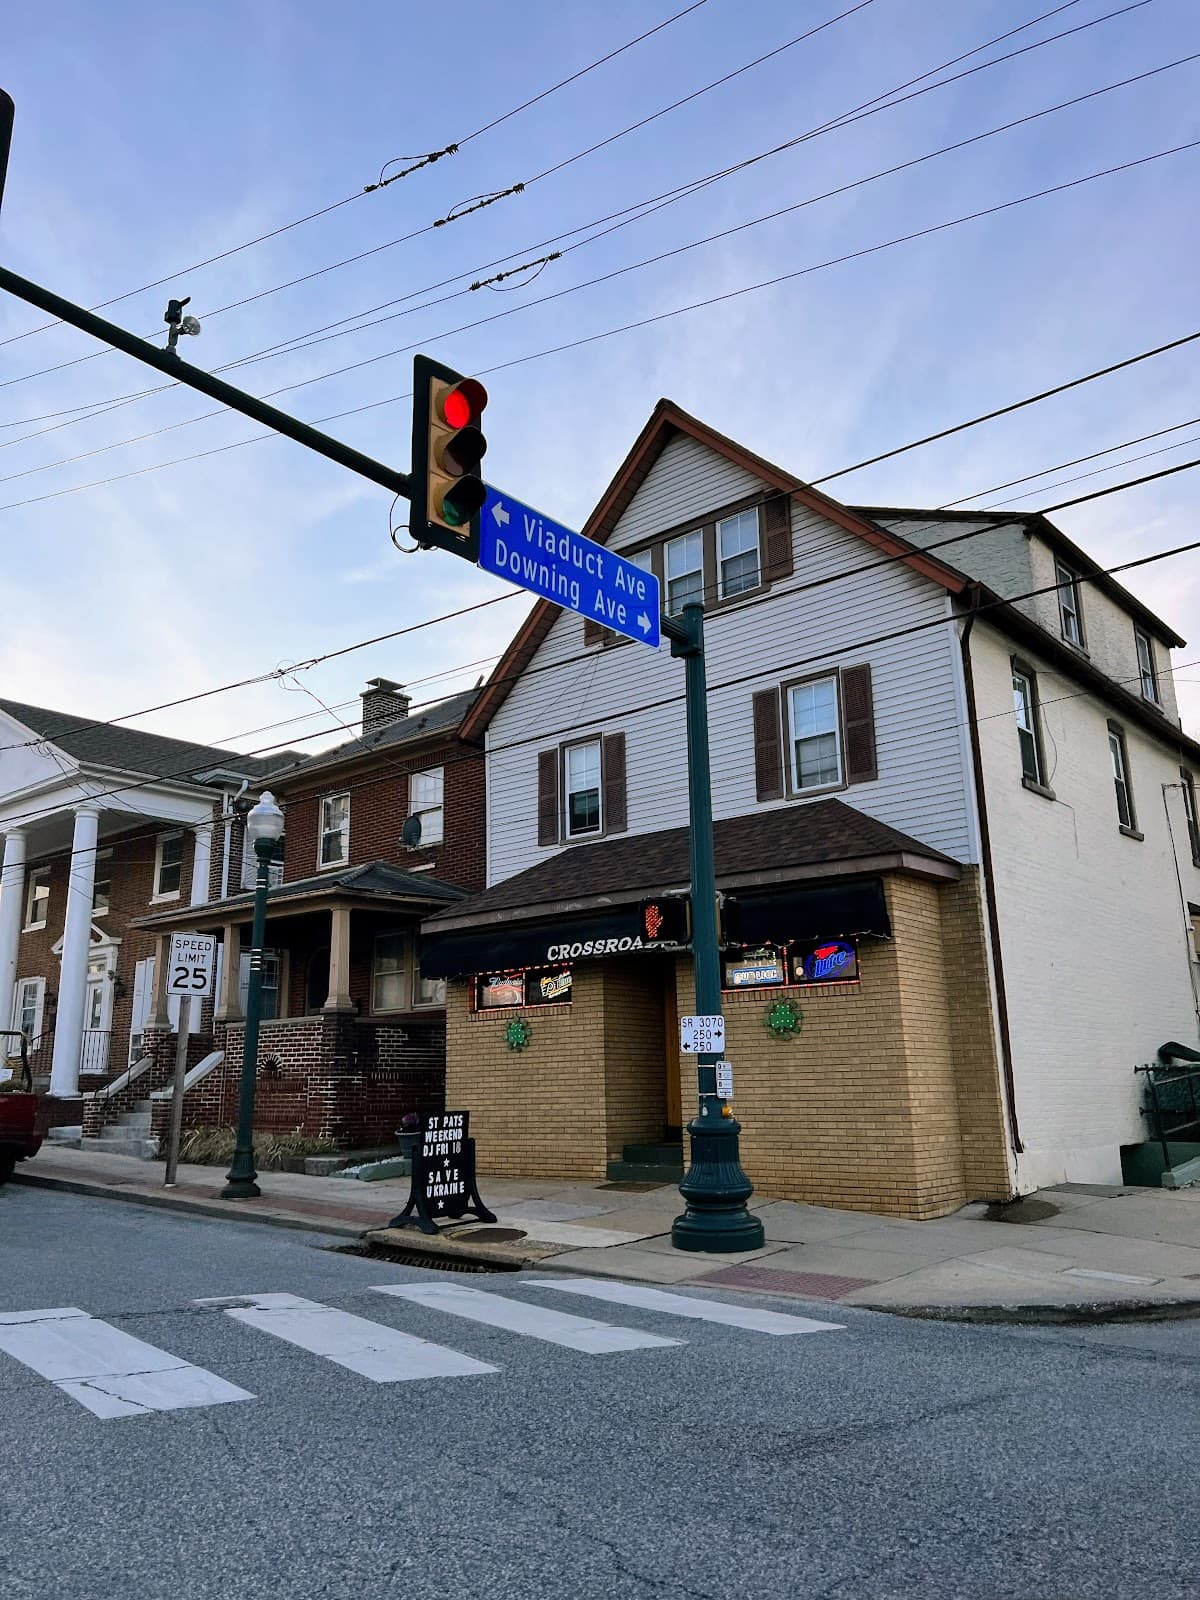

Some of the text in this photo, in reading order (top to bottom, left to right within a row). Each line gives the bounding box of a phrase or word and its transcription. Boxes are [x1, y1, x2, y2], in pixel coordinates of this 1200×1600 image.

[523, 514, 646, 601] Viaduct Ave
[495, 538, 627, 625] Downing Ave
[175, 939, 212, 951] SPEED
[547, 936, 664, 961] CROSSROA
[177, 952, 206, 964] LIMIT
[173, 966, 207, 989] 25
[682, 1017, 724, 1028] SR 3070
[693, 1029, 712, 1040] 250
[693, 1041, 712, 1052] 250
[428, 1115, 463, 1130] ST PATS
[425, 1128, 463, 1143] WEEKEND
[423, 1144, 434, 1157] DJ
[436, 1142, 449, 1156] FRI
[428, 1168, 459, 1184] SAVE
[426, 1181, 465, 1199] UKRAINE
